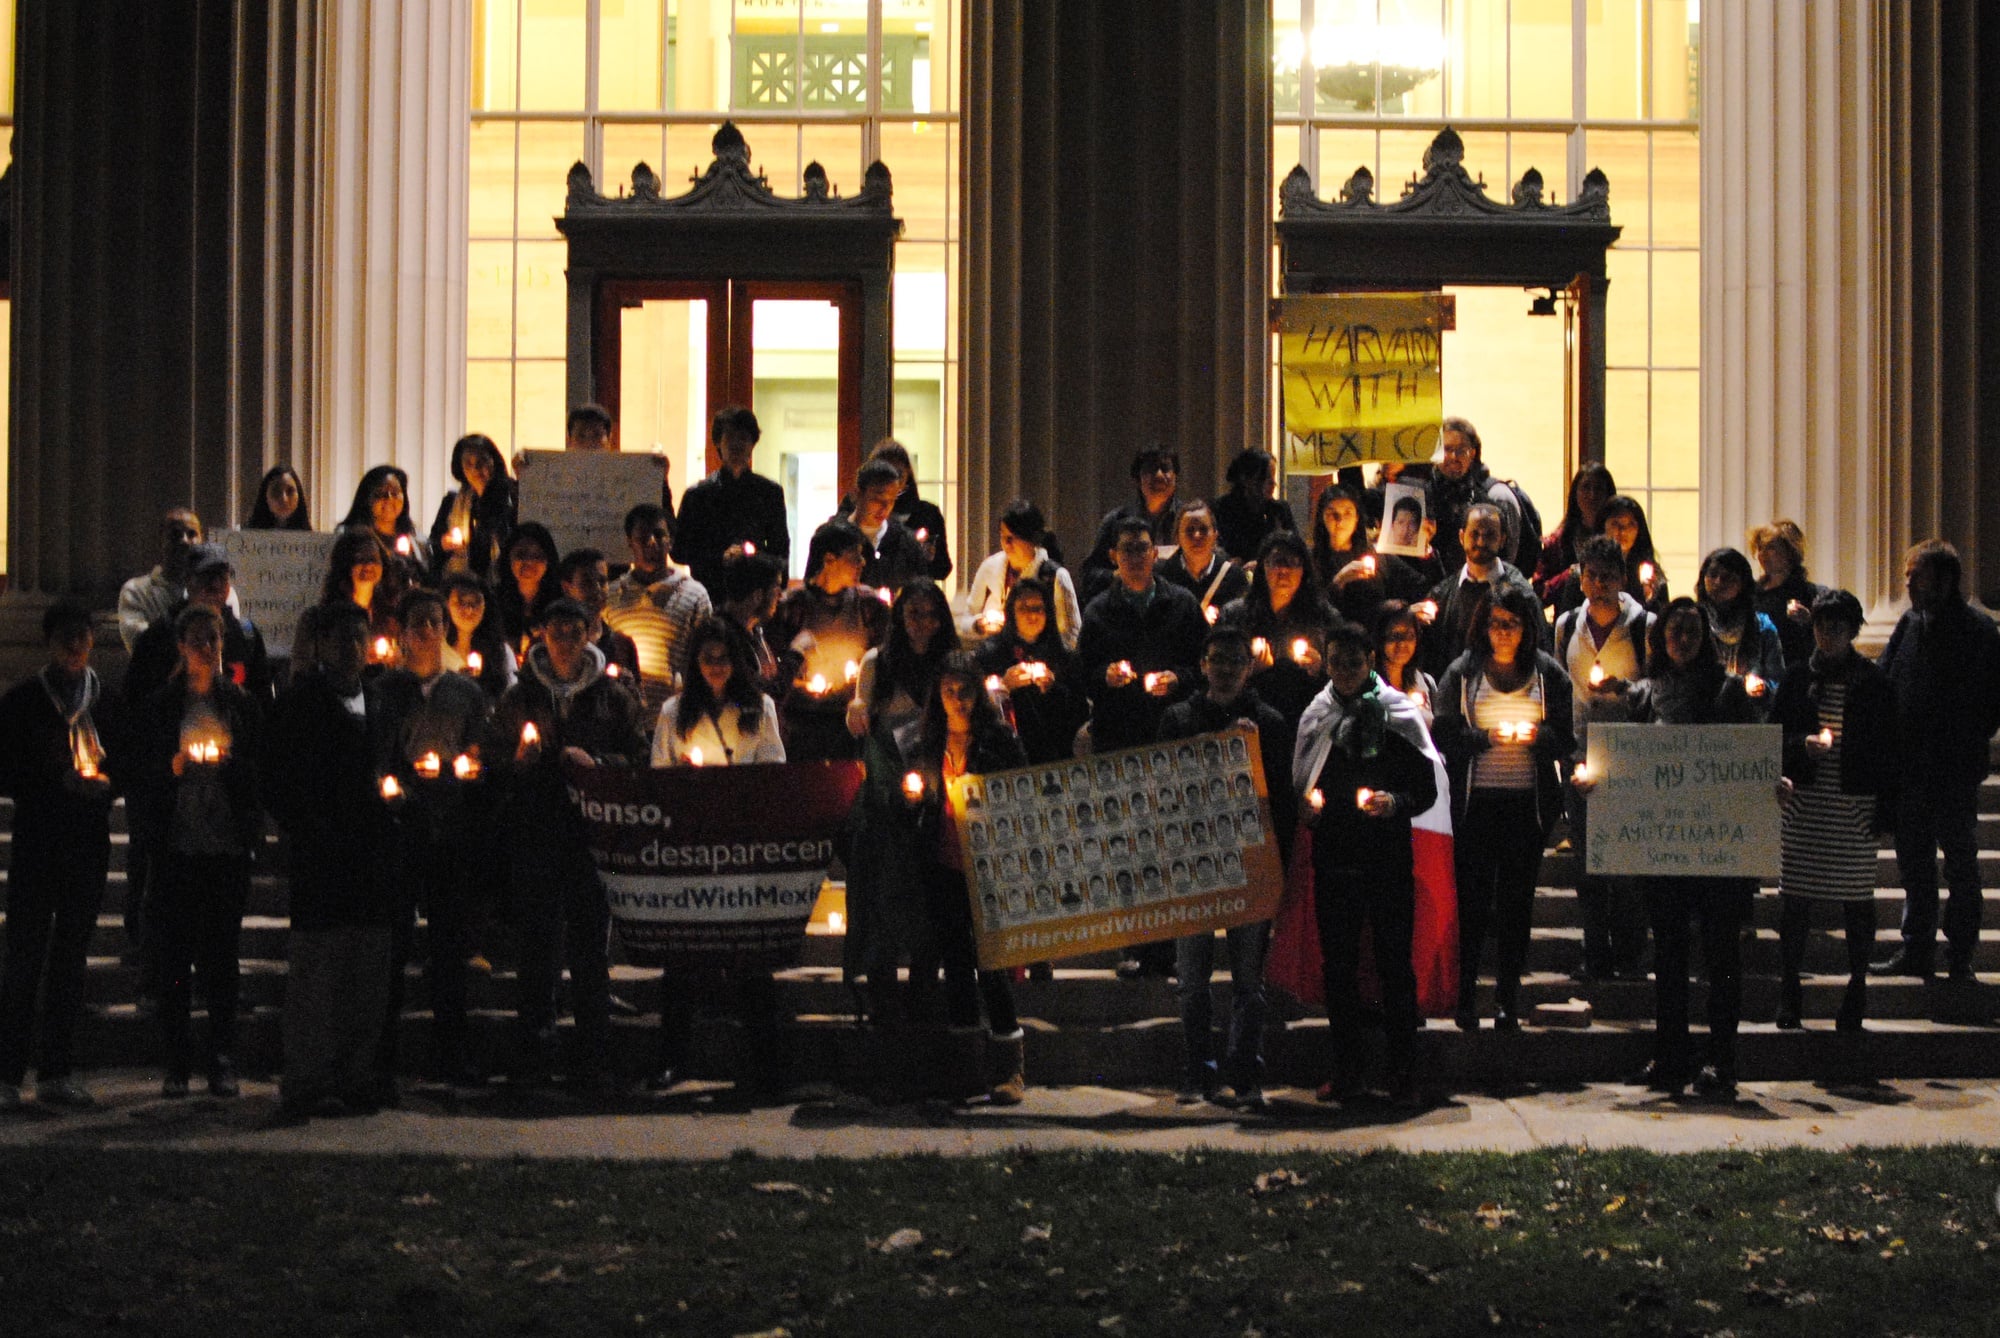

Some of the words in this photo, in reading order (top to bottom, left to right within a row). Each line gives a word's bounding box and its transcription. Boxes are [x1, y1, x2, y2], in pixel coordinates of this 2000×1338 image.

[1301, 323, 1439, 366] HARVARD
[1299, 370, 1419, 417] WITH
[1290, 424, 1441, 467] MEXICO
[1655, 762, 1685, 790] MY
[640, 838, 834, 873] desaparecen
[608, 880, 822, 909] arvardWithMexi
[1004, 896, 1247, 952] #HarvardWithMexico
